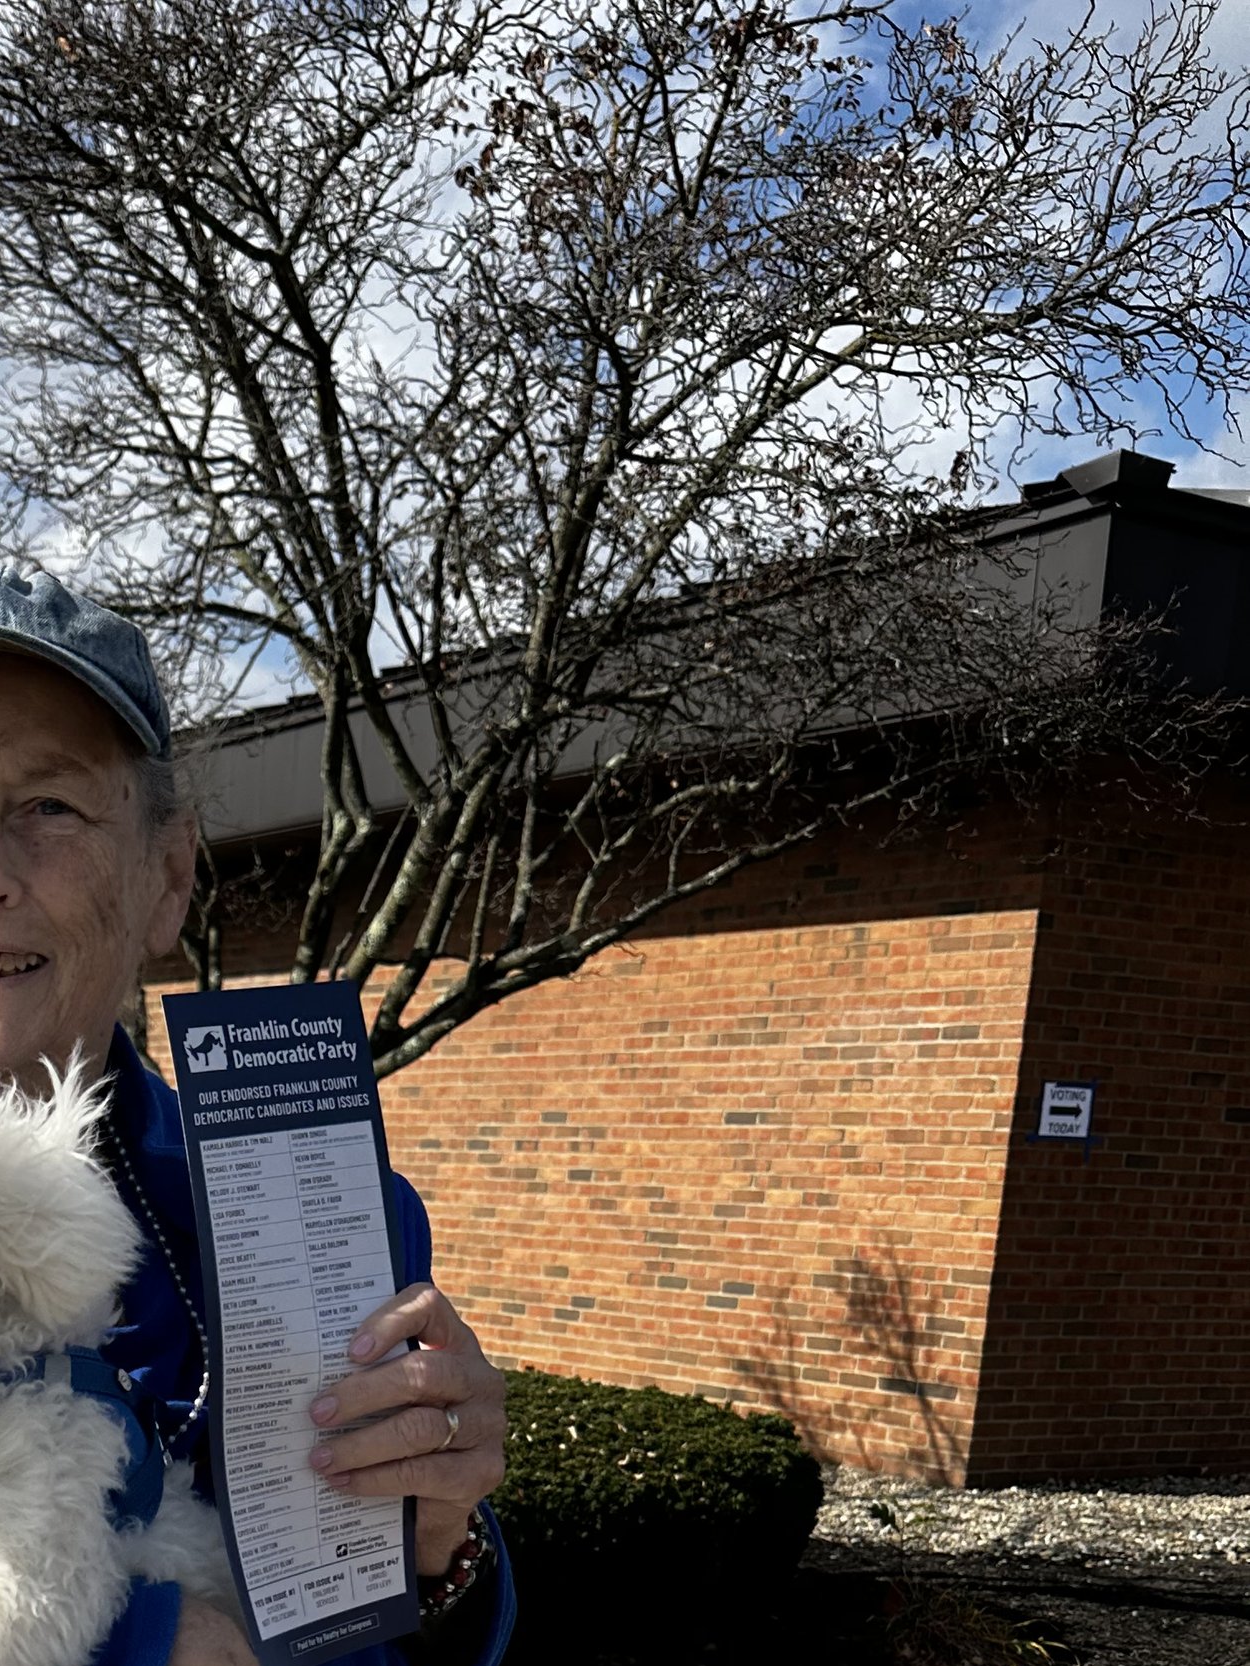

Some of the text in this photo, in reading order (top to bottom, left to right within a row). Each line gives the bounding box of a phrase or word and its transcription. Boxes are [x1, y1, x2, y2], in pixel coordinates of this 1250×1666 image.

[227, 1016, 342, 1043] Franklin County
[233, 1040, 357, 1069] Democratic Party
[198, 1075, 358, 1105] OUR ENDORSED FRANKLIN COUNTY
[1050, 1089, 1086, 1102] VOTING
[194, 1093, 370, 1126] DEMOCRATIC CANDIDATES AND ISSUES
[1048, 1122, 1081, 1134] TODAY
[357, 1566, 368, 1575] FOR
[369, 1561, 385, 1571] ISSUE
[304, 1582, 314, 1591] FOR
[316, 1577, 331, 1587] ISSUE
[273, 1591, 288, 1602] ISSUE
[297, 1640, 308, 1651] Paid
